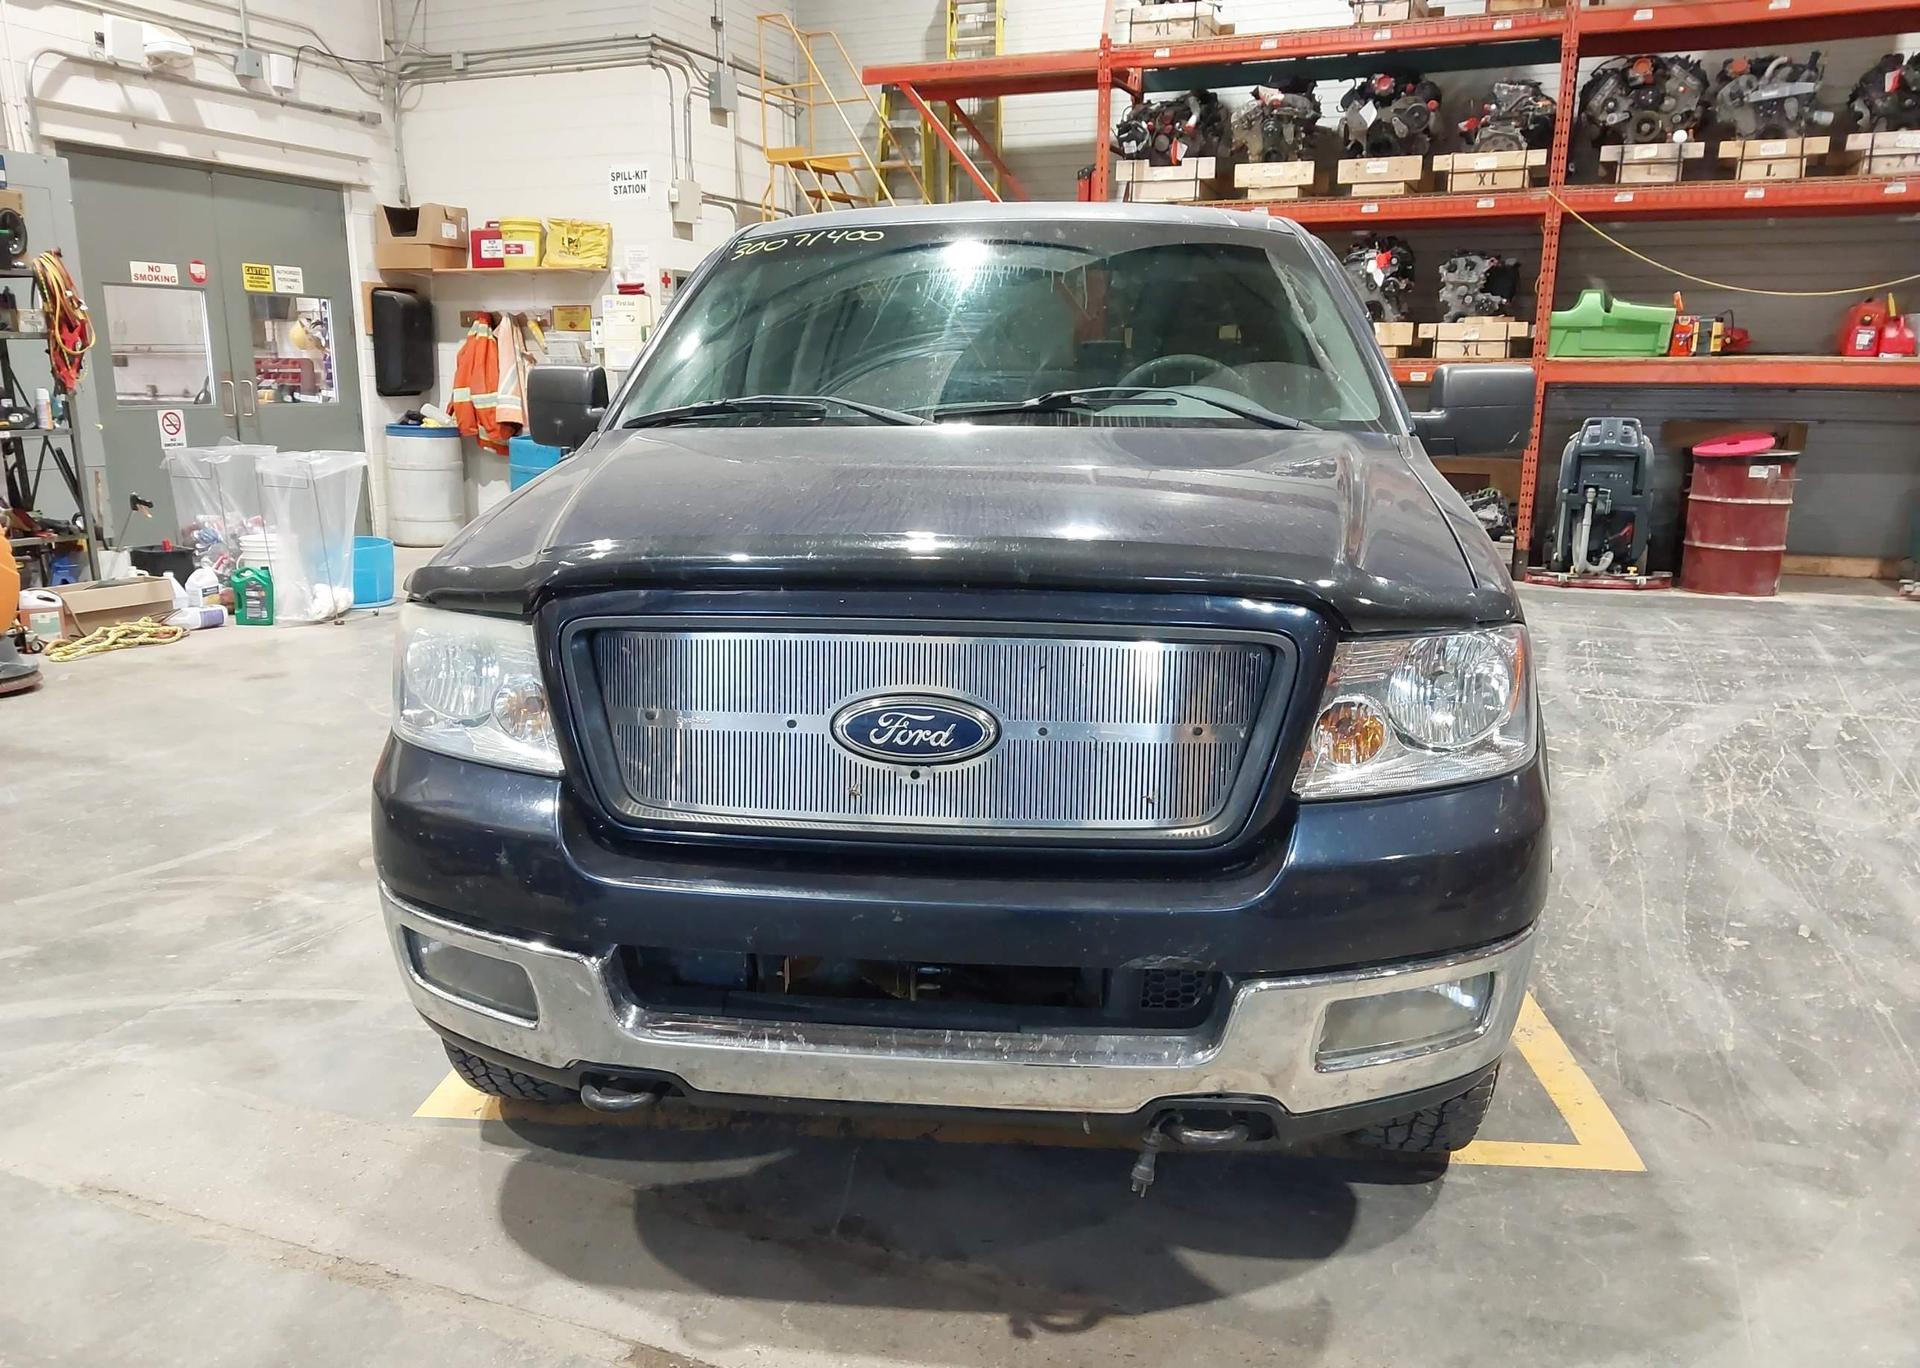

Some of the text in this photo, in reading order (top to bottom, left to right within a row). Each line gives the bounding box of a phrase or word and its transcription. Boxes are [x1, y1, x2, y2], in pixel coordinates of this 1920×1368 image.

[610, 169, 648, 181] SPILL-KIT
[613, 183, 646, 195] STATION
[147, 264, 161, 273] NO
[245, 266, 270, 276] CAUTION
[133, 272, 177, 284] SMOKING
[869, 711, 957, 748] Ford
